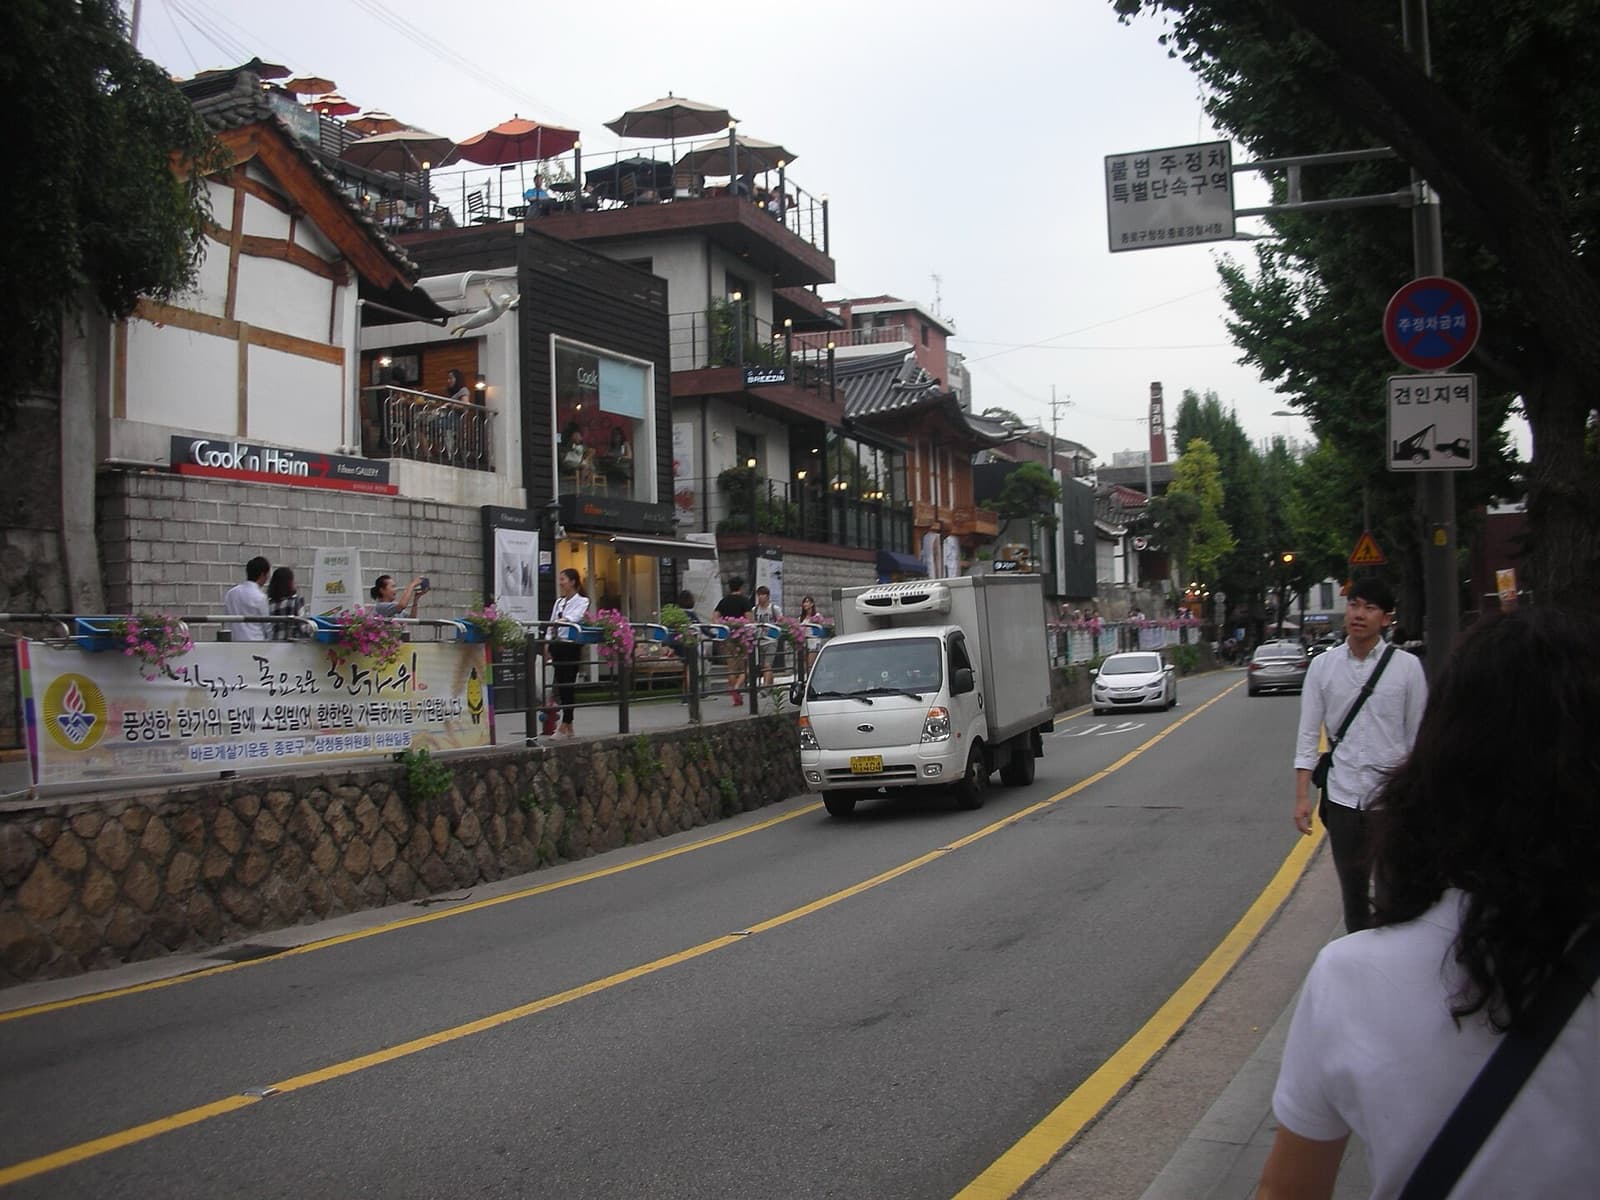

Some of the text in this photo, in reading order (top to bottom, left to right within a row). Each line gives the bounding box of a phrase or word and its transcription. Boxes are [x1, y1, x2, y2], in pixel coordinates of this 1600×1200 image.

[1111, 157, 1150, 181] 불법
[1112, 172, 1228, 203] 특별단속구역
[1397, 314, 1467, 333] 주정차금지
[1394, 384, 1470, 405] 견인지역
[265, 449, 309, 478] Heim
[123, 697, 463, 742] 풍성한 한가위 달에 소원빌어 환한일 가득하시길 기원합니다
[191, 731, 412, 762] 바르게살기운동 종로구 삼청동위원회 위원일동
